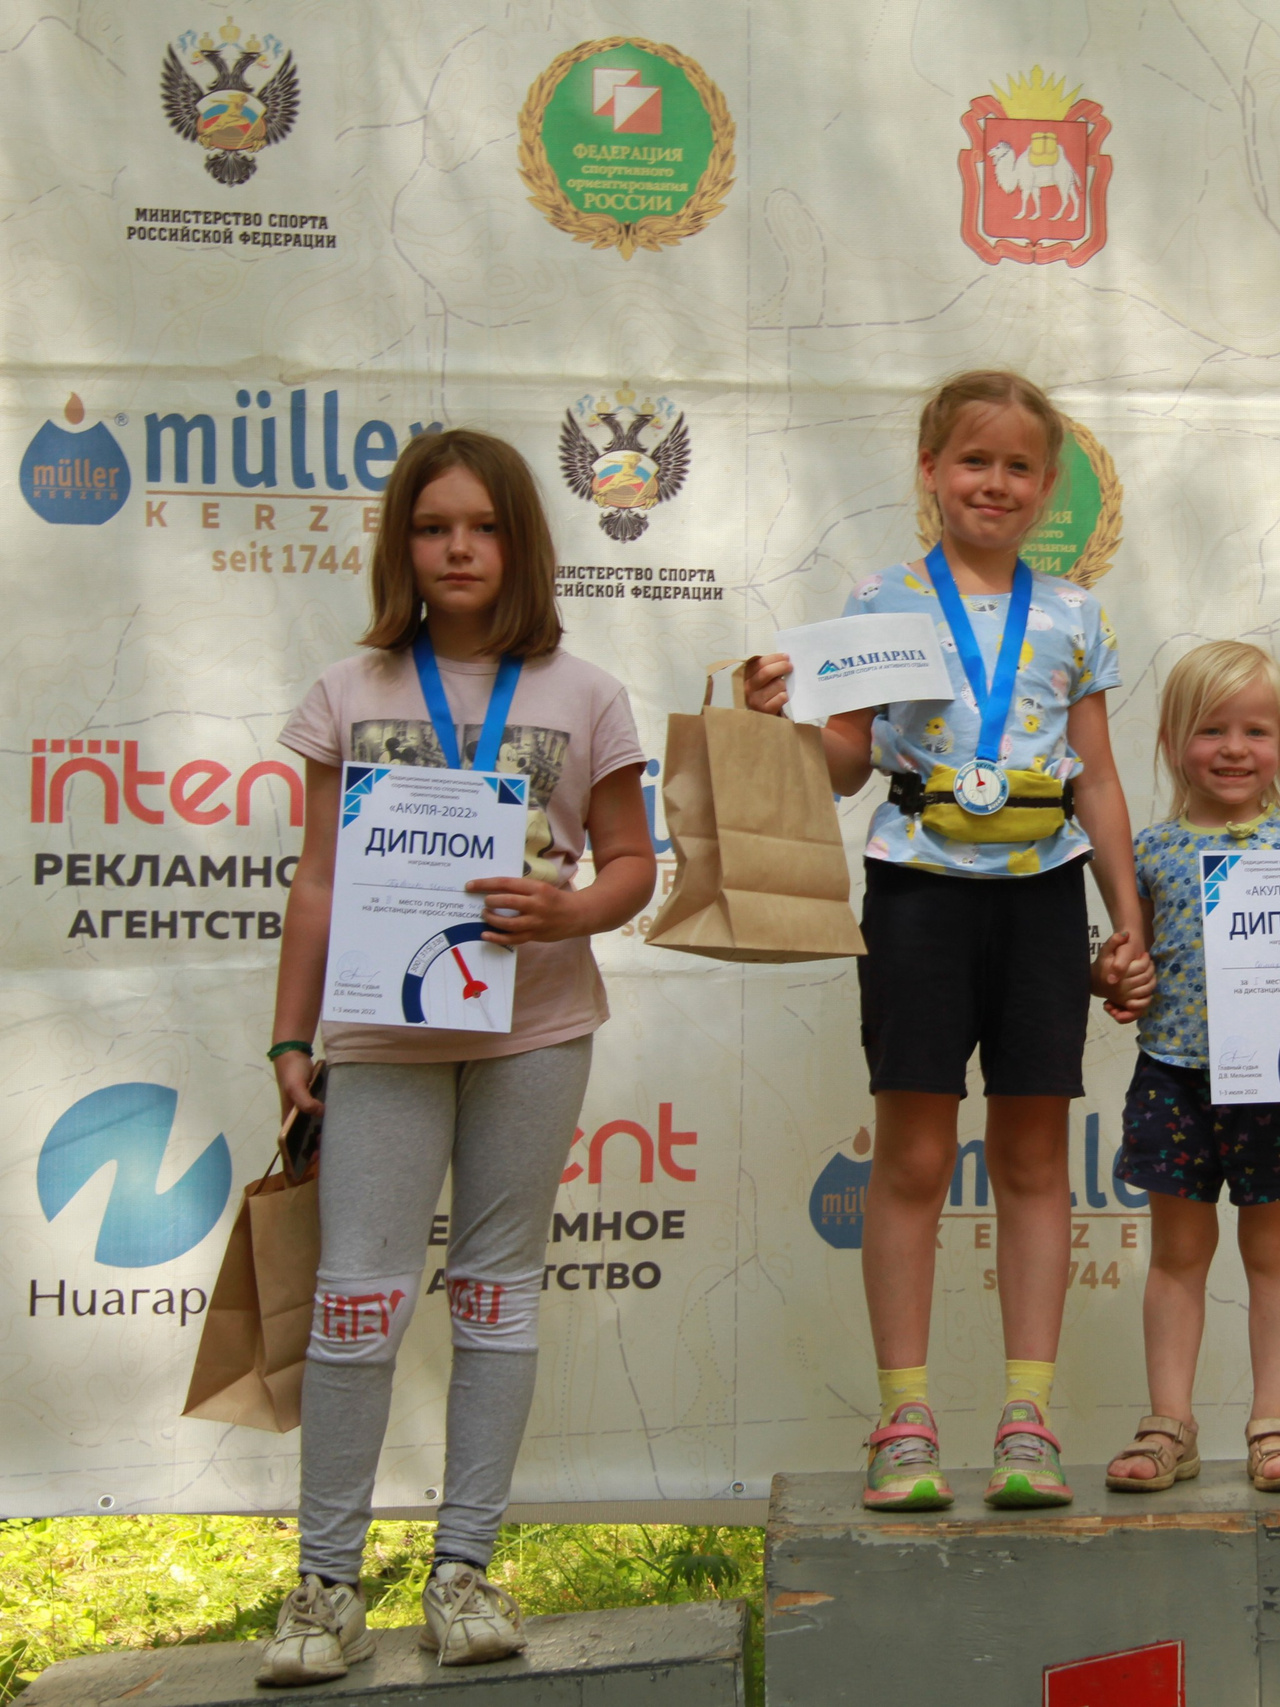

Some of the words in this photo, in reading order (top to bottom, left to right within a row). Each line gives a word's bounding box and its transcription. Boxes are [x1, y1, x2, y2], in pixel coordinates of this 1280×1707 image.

[572, 144, 684, 164] ФЕДЕРАЦИЯ
[581, 164, 675, 178] спортивного
[566, 178, 689, 193] ориентирования
[583, 193, 672, 211] РОССИИ
[135, 208, 262, 227] МИНИСТЕРСТВО
[268, 213, 329, 230] СПОРТА
[127, 226, 233, 244] РОССИЙСКОЙ
[239, 231, 337, 249] ФЕДЕРАЦИИ
[145, 389, 444, 491] mülle
[33, 458, 120, 488] müller
[146, 501, 380, 533] KERZE
[212, 543, 273, 574] seit
[283, 544, 362, 575] 1744
[556, 565, 653, 581] НИСТЕРСТВО
[659, 568, 716, 582] СПОРТА
[555, 582, 625, 598] СИЙСКОЙ
[631, 585, 724, 602] ФЕДЕРАЦИИ
[840, 649, 926, 669] МАНАРАГА
[30, 738, 304, 827] inten
[389, 802, 478, 819] «АКУЛЯ-2022»
[365, 827, 494, 860] ДИПЛОМ
[34, 853, 301, 888] РЕКЛАМНО
[67, 909, 282, 940] АГЕНТСТВ
[29, 1279, 207, 1327] Ниагар
